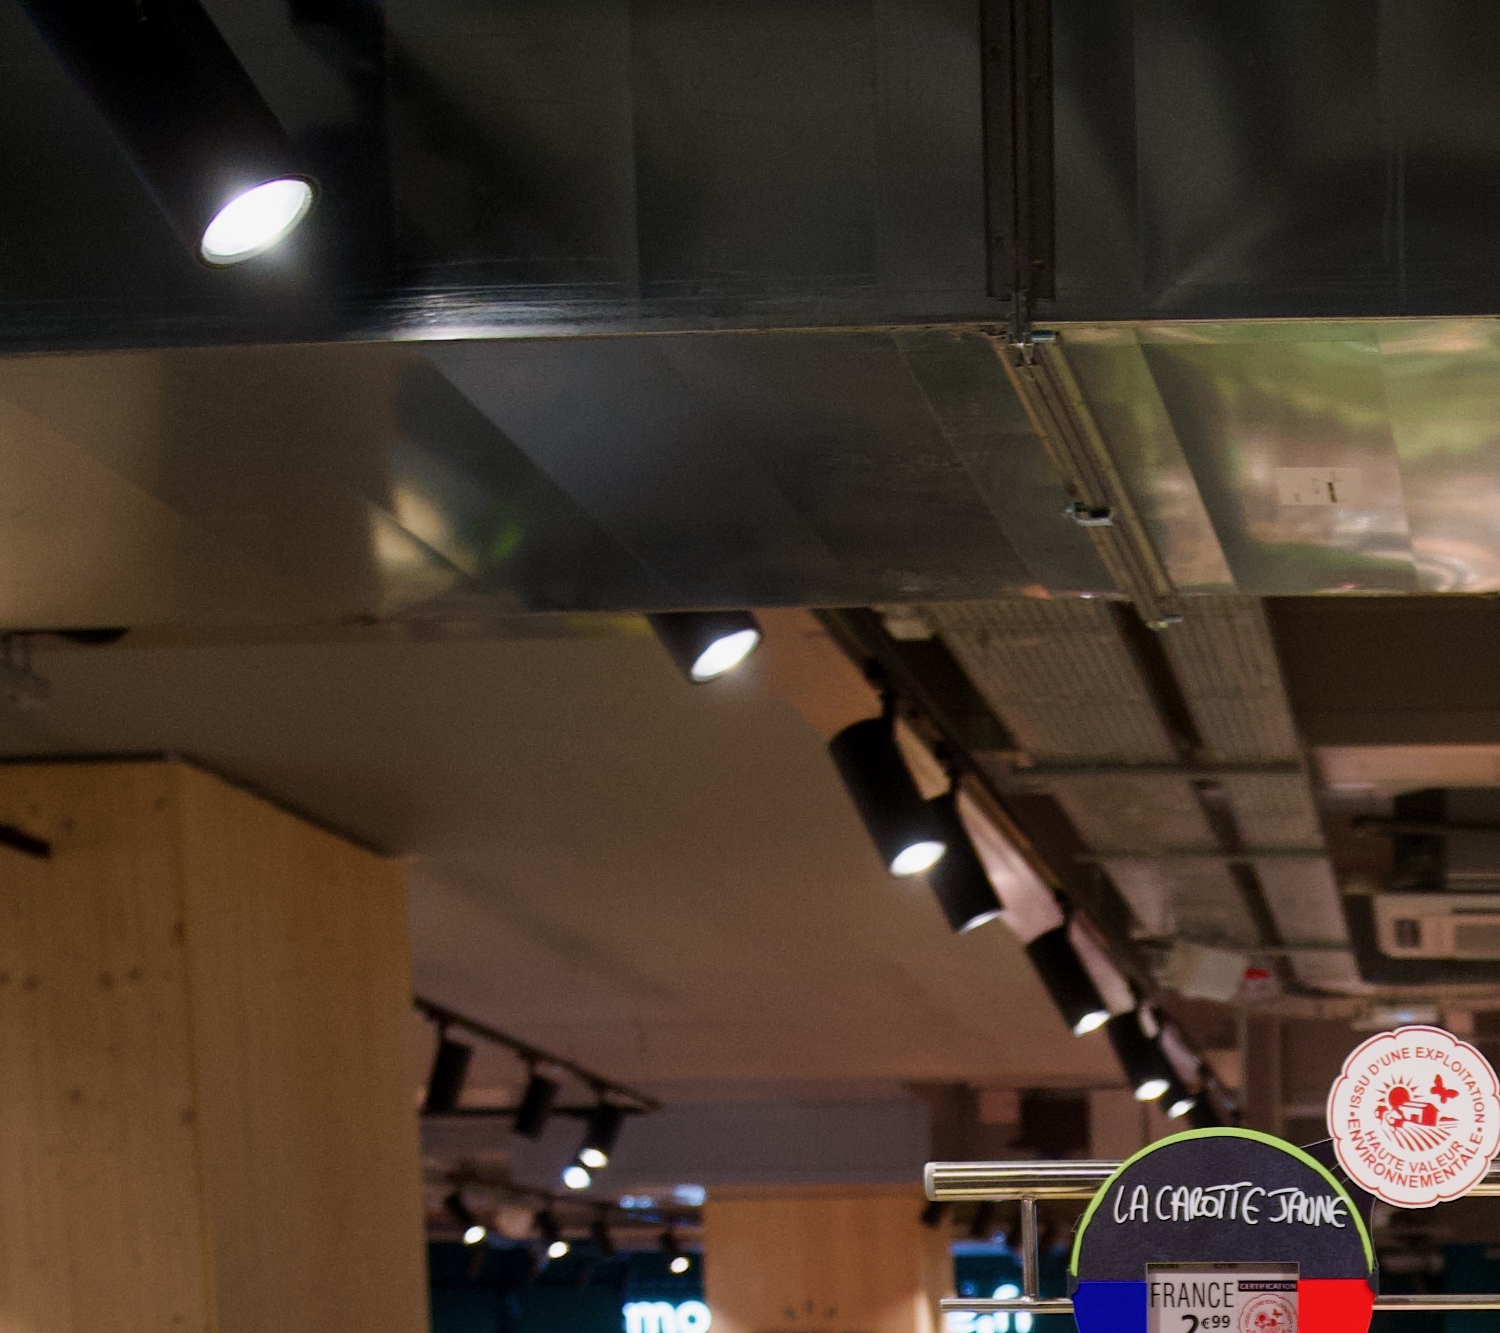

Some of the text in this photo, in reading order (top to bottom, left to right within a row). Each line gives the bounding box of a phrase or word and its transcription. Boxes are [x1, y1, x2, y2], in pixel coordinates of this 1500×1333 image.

[1349, 1046, 1486, 1123] ISSU D'UNE EXPLOITATION
[1347, 1118, 1484, 1188] ENVIRONNEMENTALE
[1364, 1130, 1463, 1173] HAUTE VALEUR
[1113, 1182, 1348, 1228] LA CAROTTE JAUNE
[1150, 1281, 1235, 1309] FRANCE
[1239, 1282, 1296, 1290] CERTIFICATION
